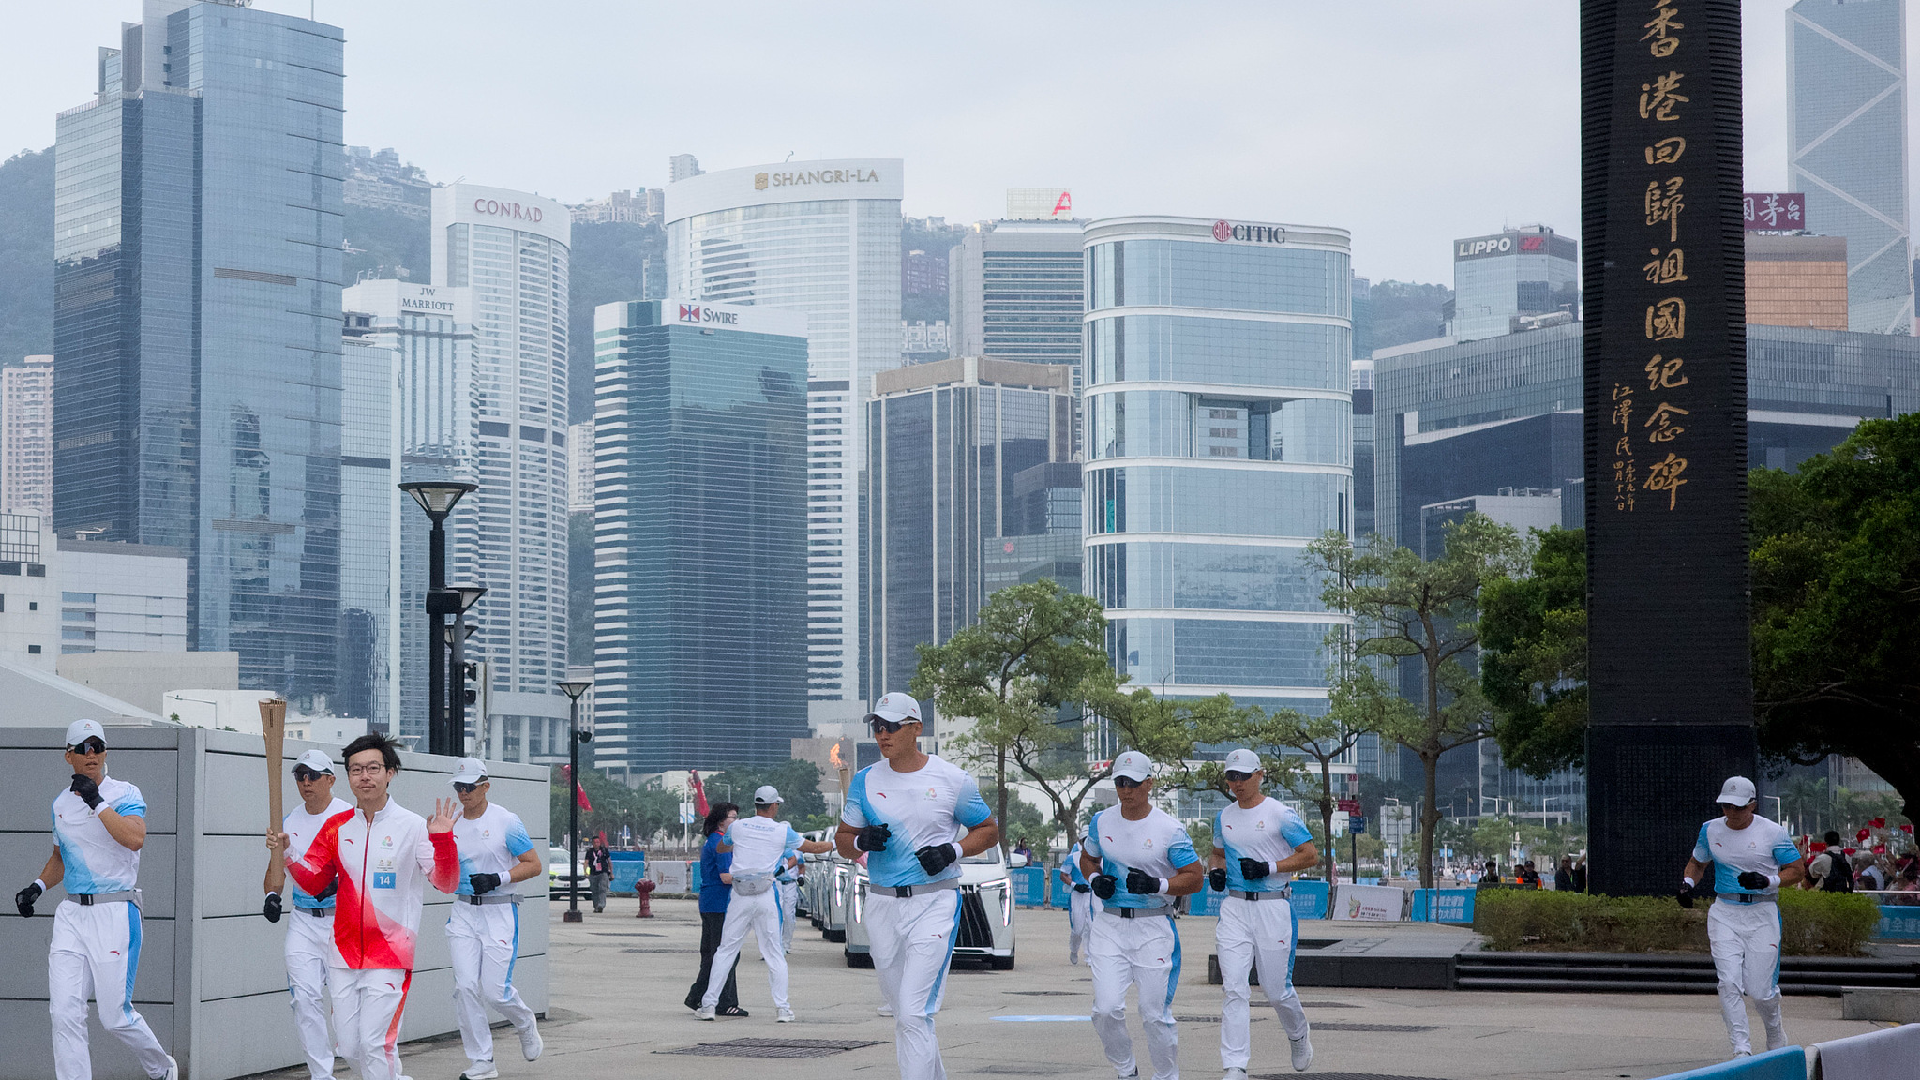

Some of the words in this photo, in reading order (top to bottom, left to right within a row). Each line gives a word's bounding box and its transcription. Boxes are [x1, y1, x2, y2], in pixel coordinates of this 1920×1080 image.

[773, 169, 879, 187] SHANGRI-LA
[474, 198, 543, 223] CONRAD
[1232, 223, 1286, 244] CITIC
[1458, 237, 1511, 257] LIPPO
[1640, 0, 1690, 511] 香港回歸祖國紀念碑
[420, 287, 436, 297] JW
[402, 298, 454, 311] MARRIOTT
[380, 876, 390, 885] 14
